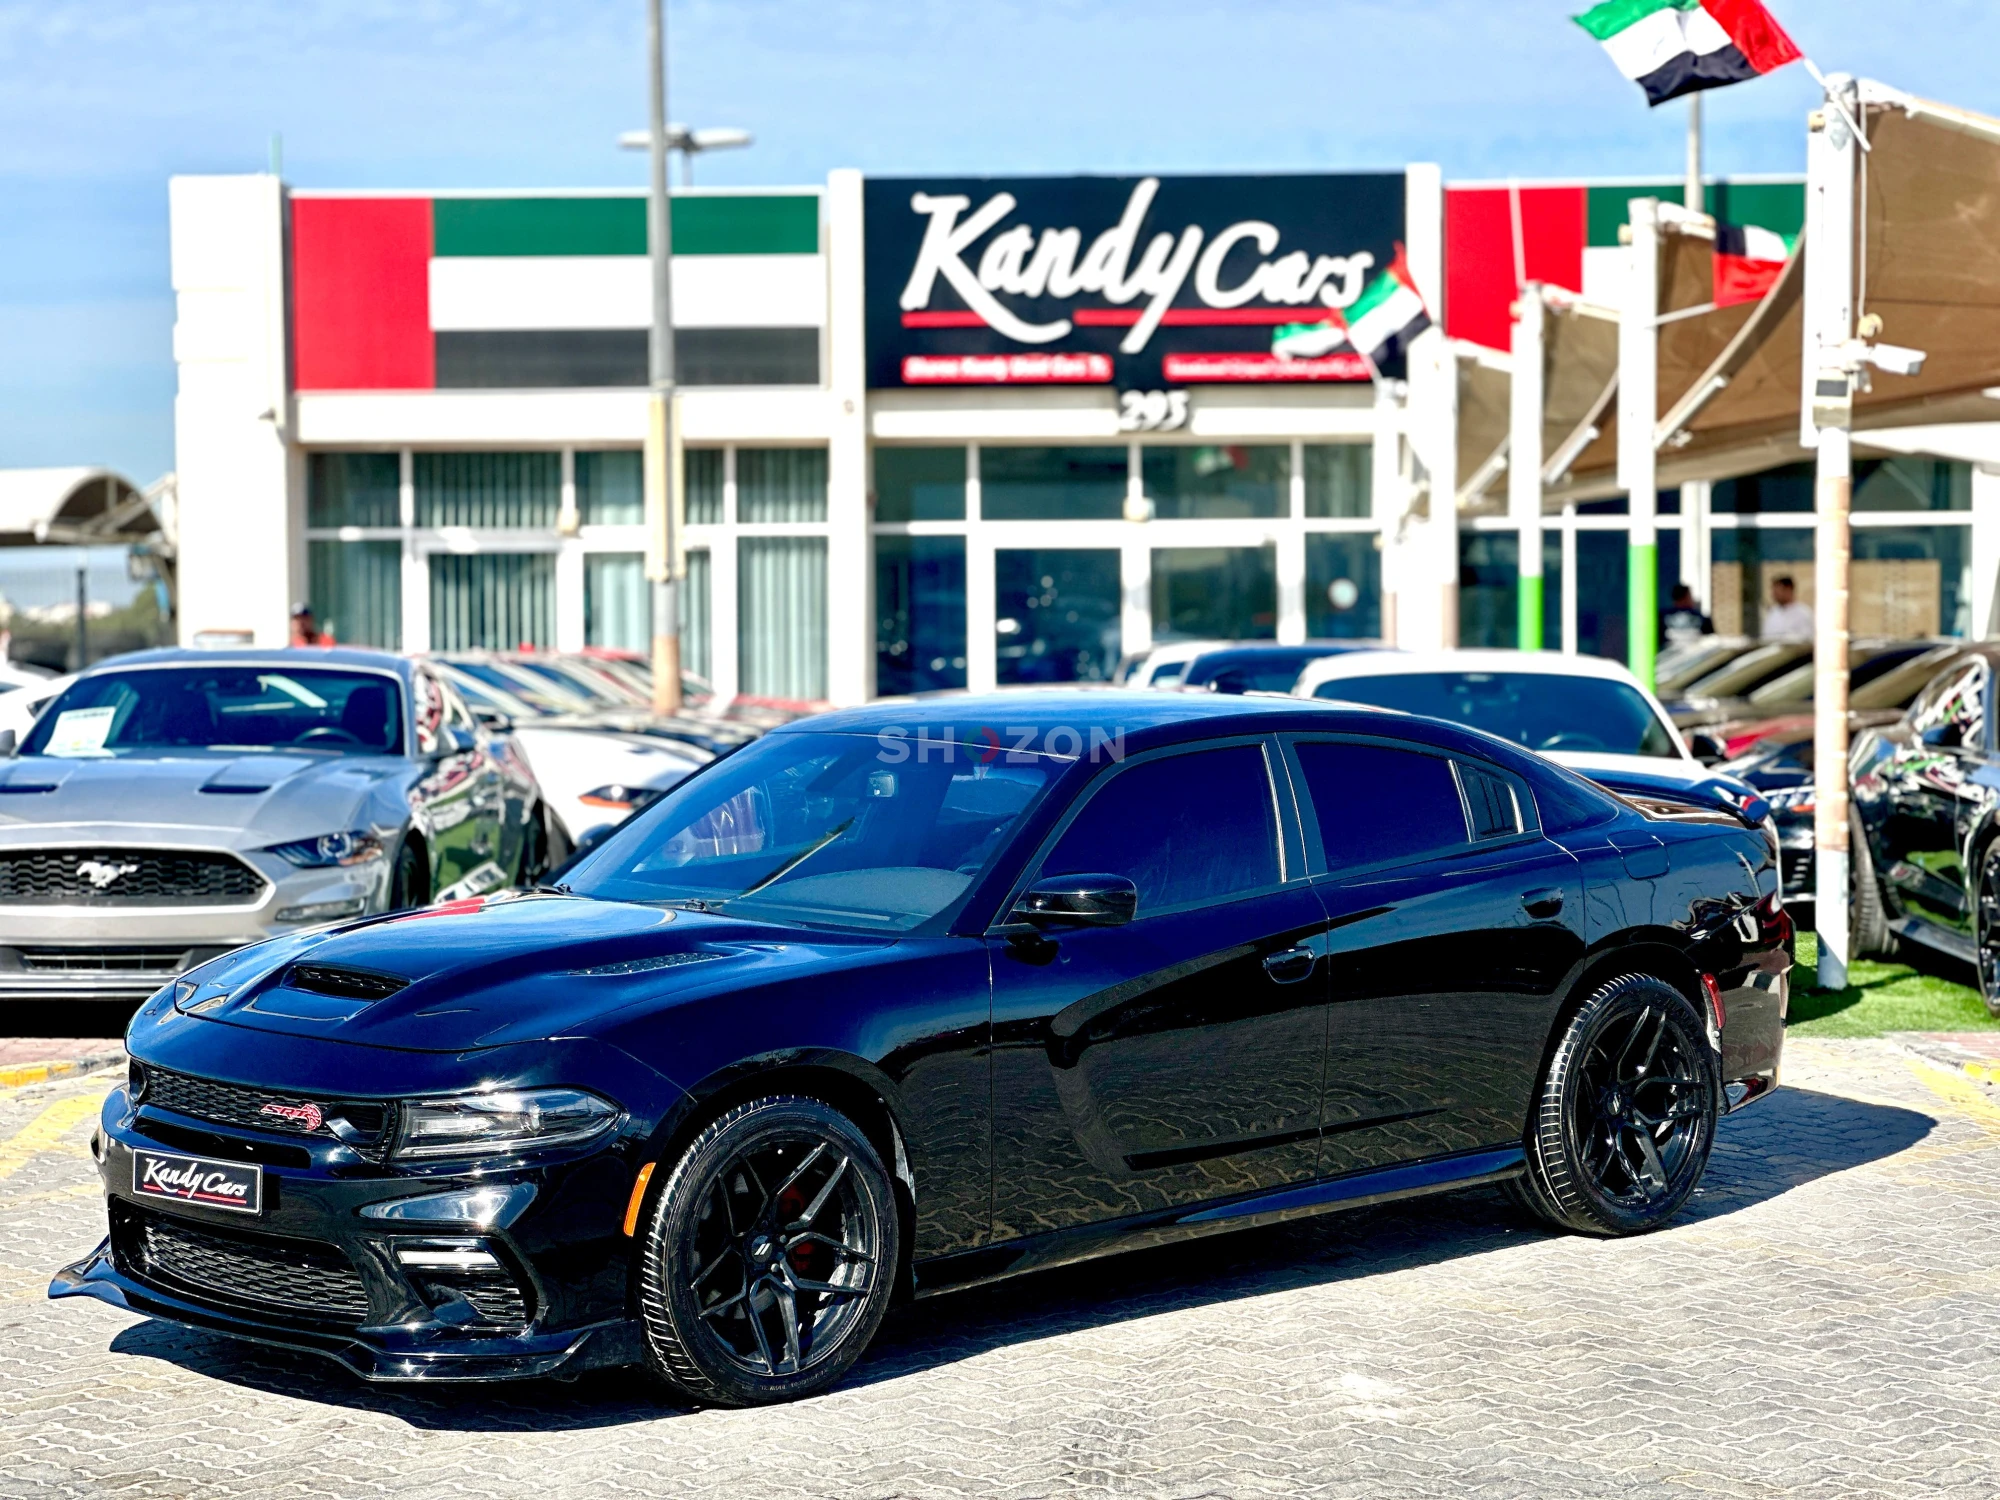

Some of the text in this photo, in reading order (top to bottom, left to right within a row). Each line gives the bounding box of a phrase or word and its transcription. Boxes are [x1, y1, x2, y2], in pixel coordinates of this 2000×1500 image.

[900, 177, 1374, 354] Kandy Cars
[1119, 389, 1190, 432] 295
[261, 1104, 309, 1120] SRT
[143, 1157, 249, 1199] Kandy Cars
